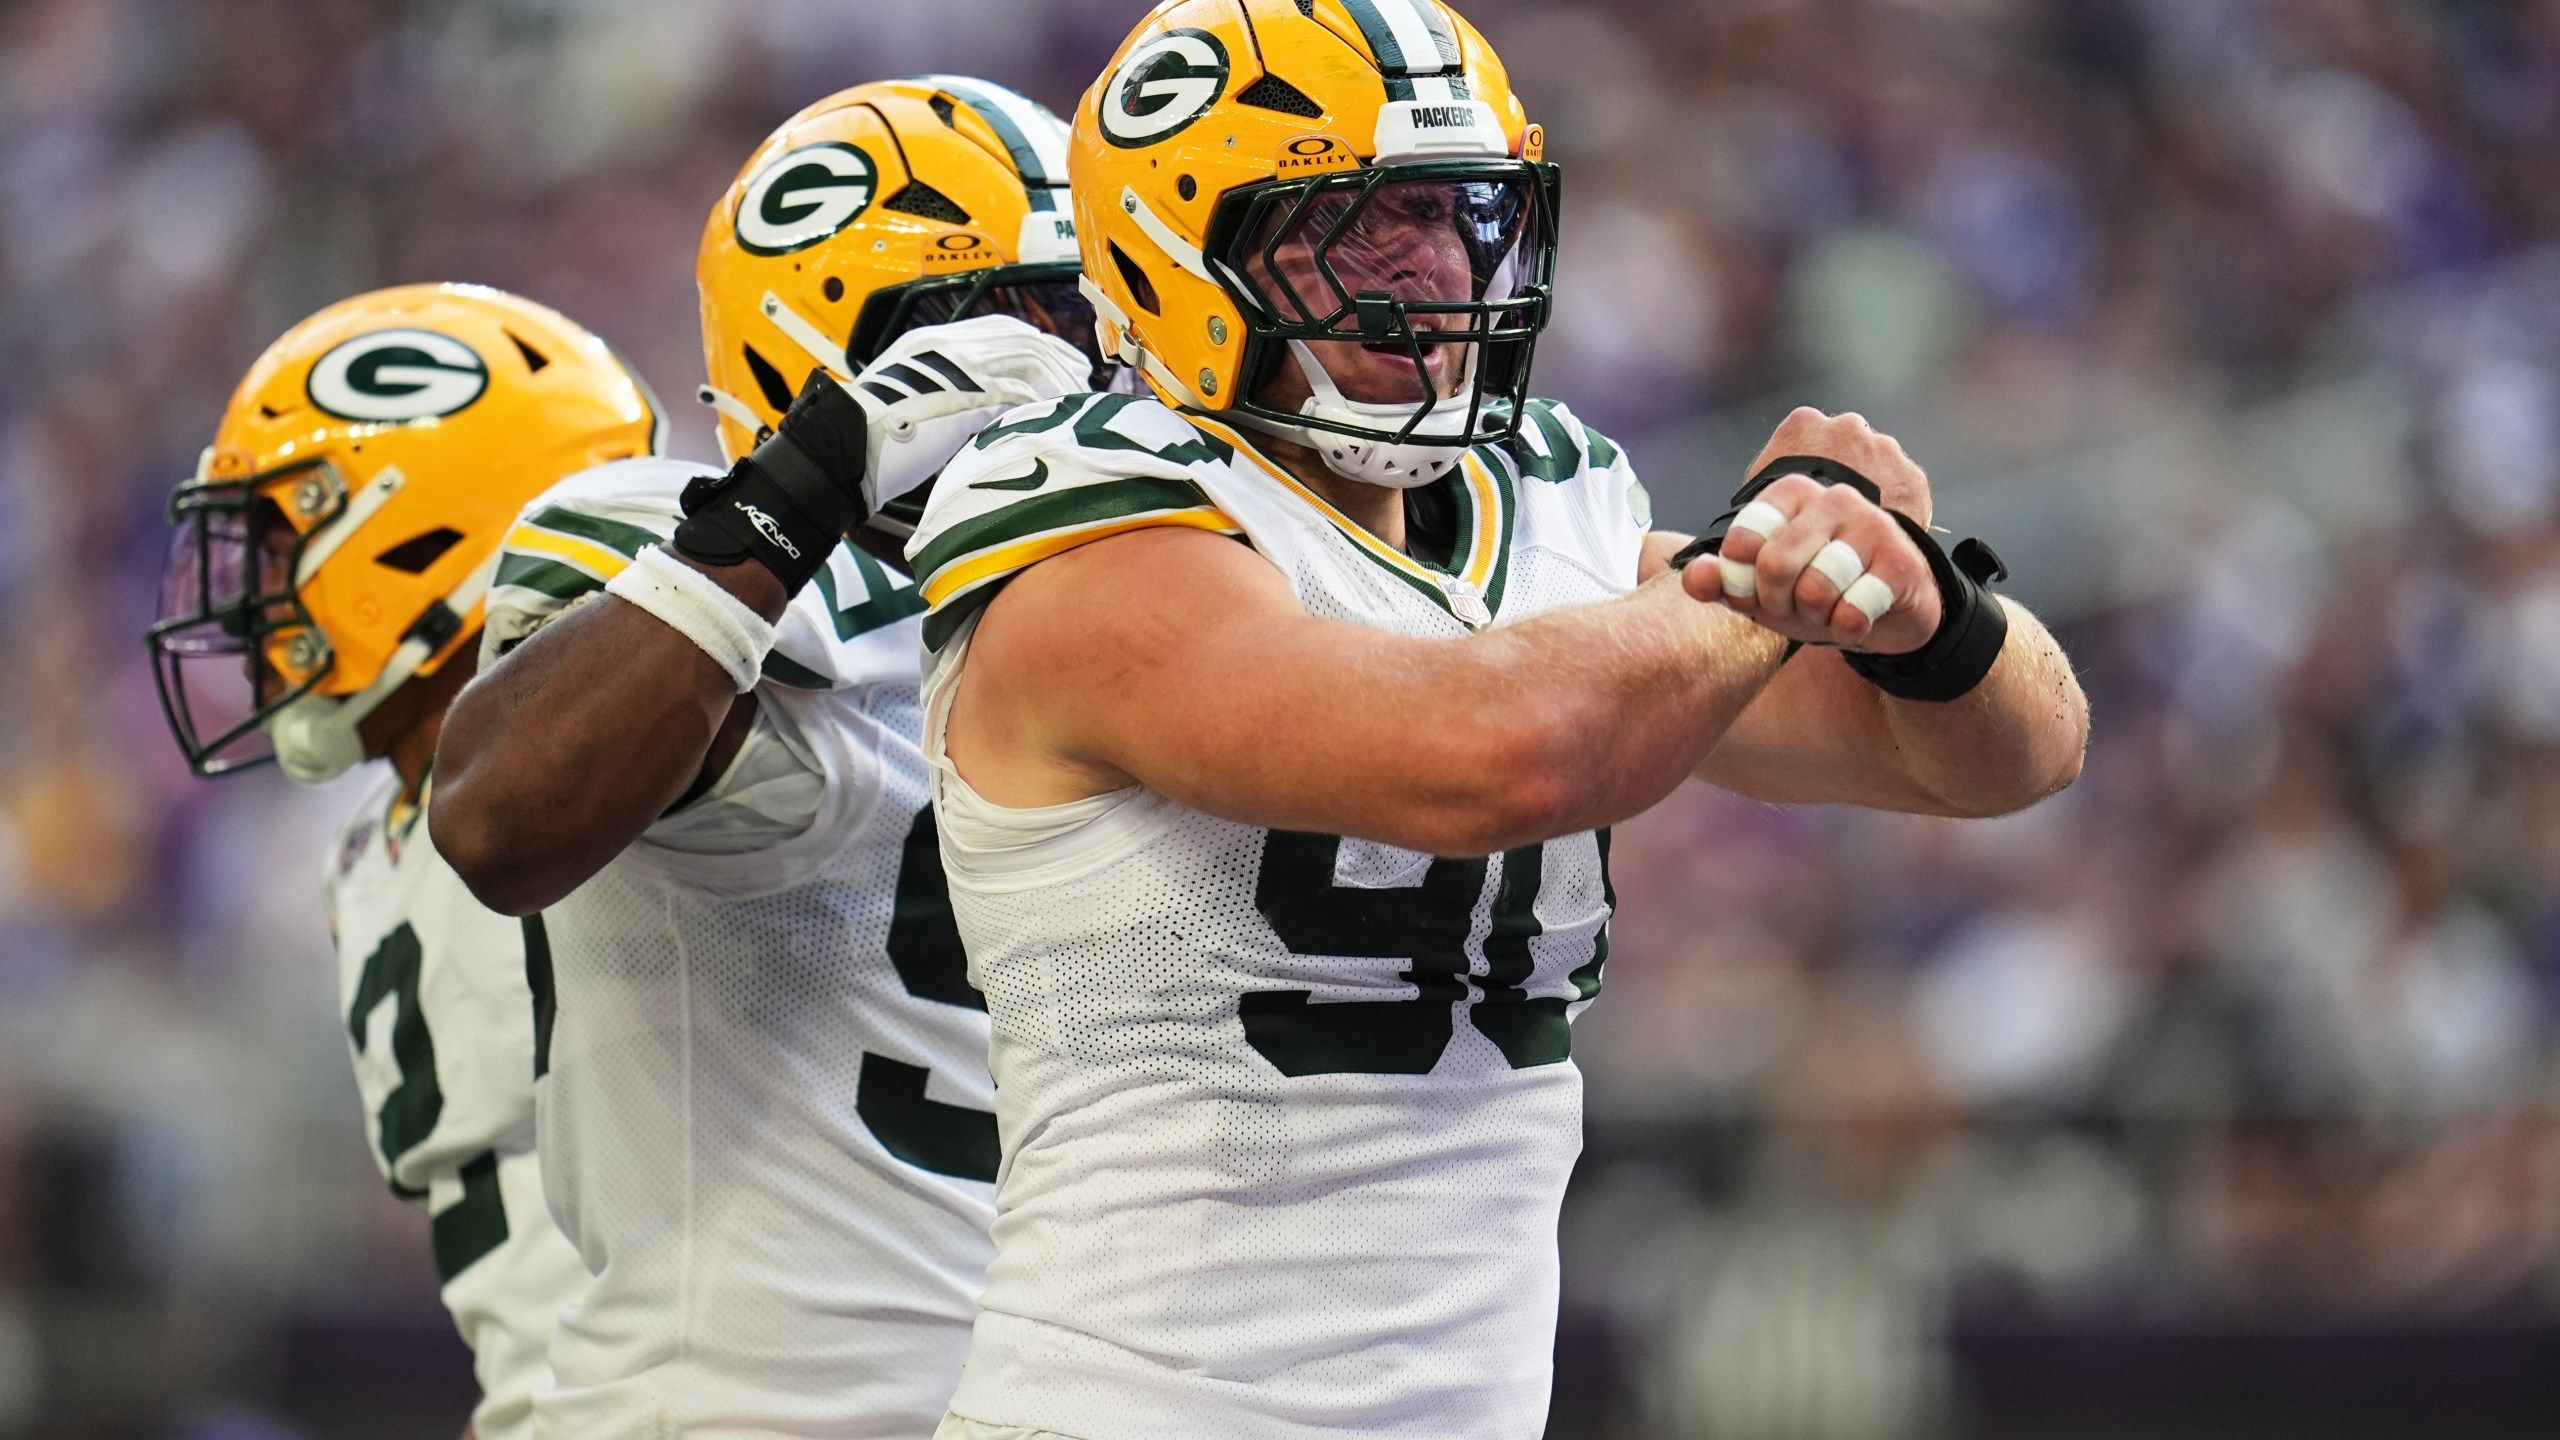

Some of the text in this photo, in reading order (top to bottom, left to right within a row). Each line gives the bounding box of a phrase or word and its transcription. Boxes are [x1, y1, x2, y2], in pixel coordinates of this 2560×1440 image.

[1101, 33, 1223, 140] G
[1411, 107, 1475, 129] PACKERS
[735, 146, 869, 250] G
[1279, 153, 1347, 168] OAKLEY
[925, 252, 993, 262] OAKLEY
[308, 329, 488, 421] G
[1239, 824, 1616, 1078] 90
